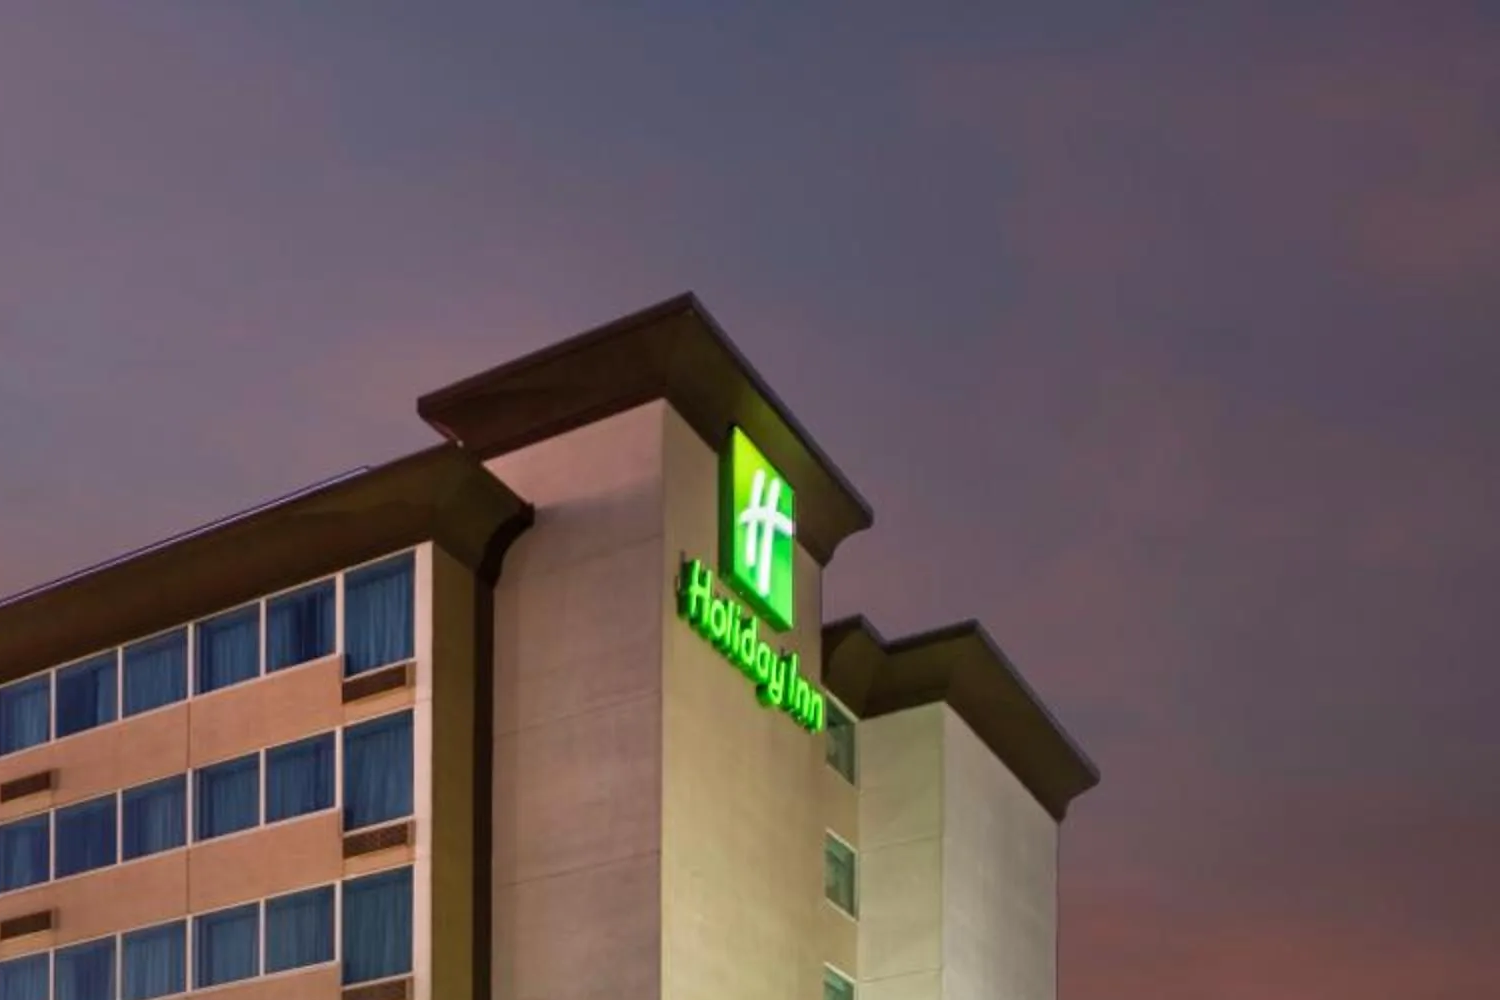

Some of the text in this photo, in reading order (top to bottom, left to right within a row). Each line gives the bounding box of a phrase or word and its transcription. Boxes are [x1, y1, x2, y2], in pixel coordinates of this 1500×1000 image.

[739, 468, 796, 598] H
[687, 558, 824, 732] Holiday Inn
